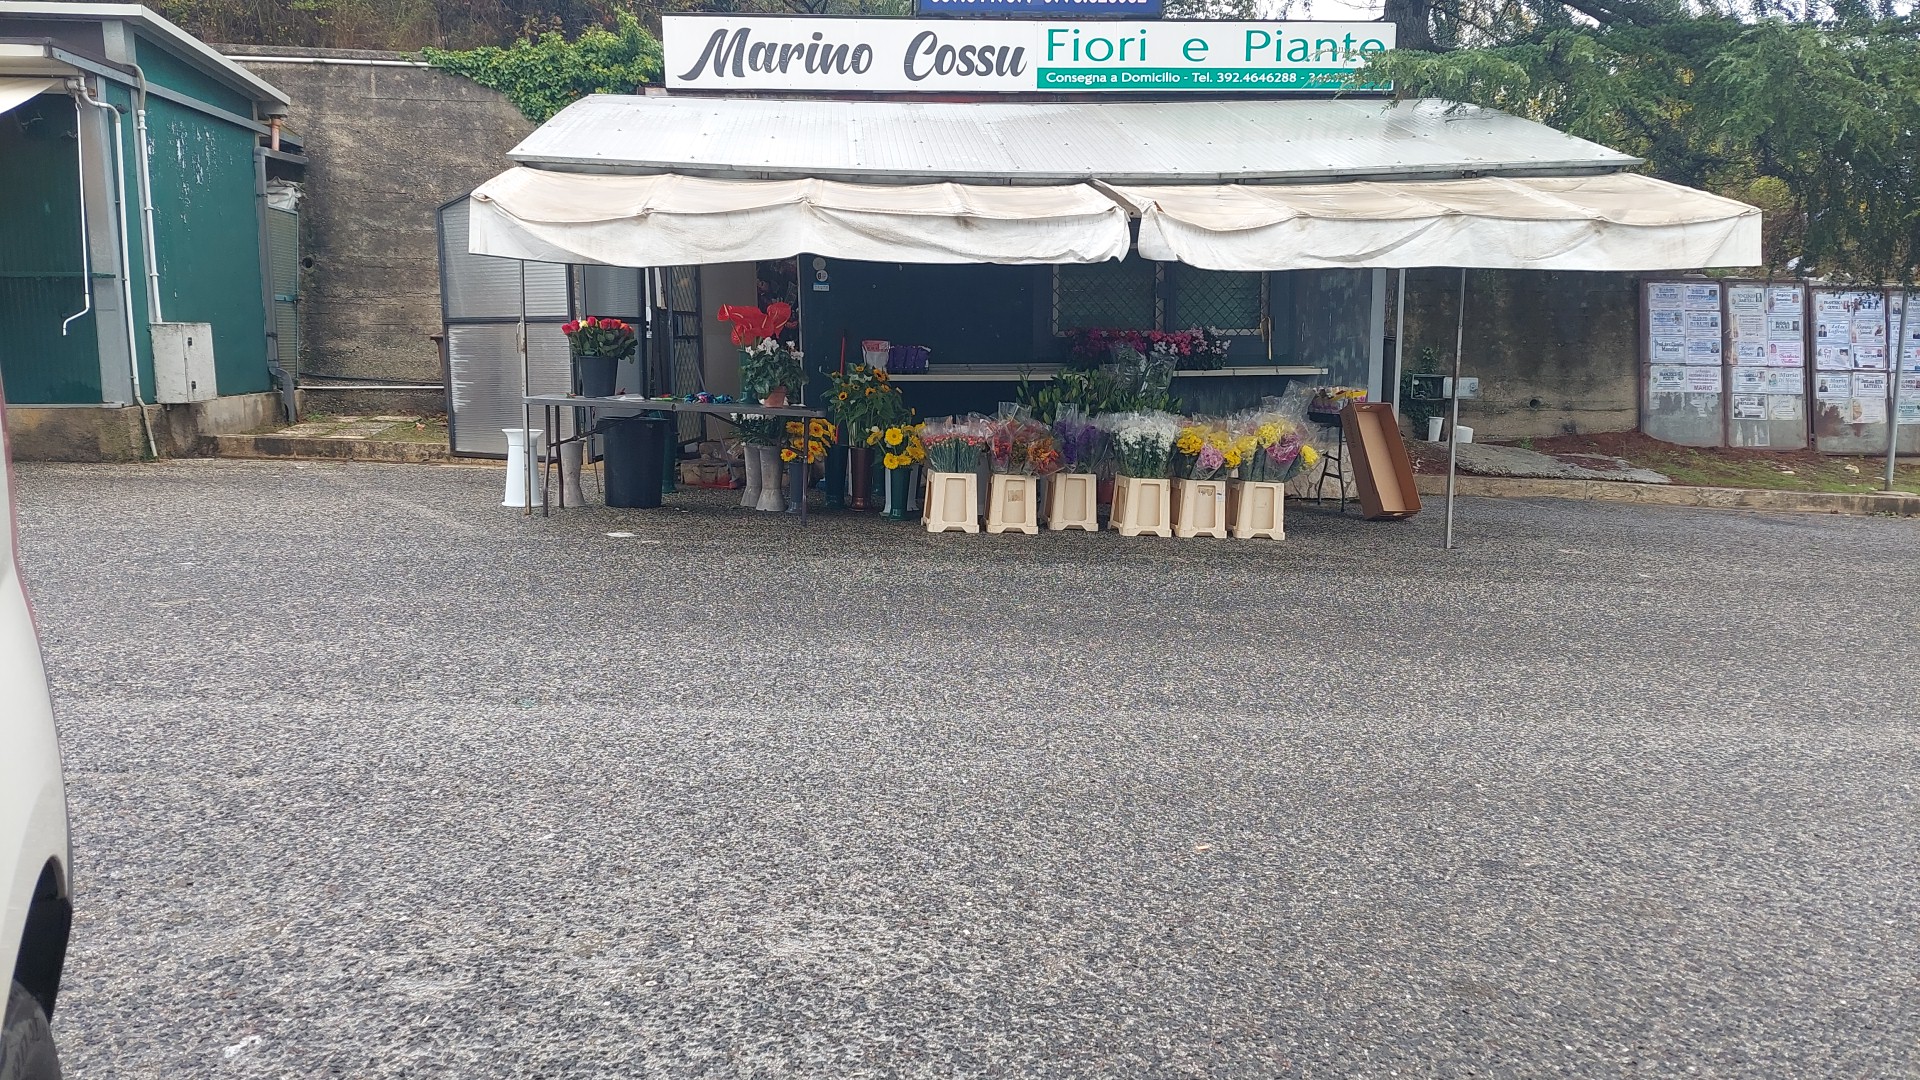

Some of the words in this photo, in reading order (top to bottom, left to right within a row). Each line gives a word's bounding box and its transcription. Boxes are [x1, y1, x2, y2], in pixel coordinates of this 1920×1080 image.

[677, 28, 873, 81] Marino
[904, 30, 1027, 82] Cossu
[1047, 28, 1146, 62] Fiori
[1182, 38, 1209, 62] e
[1245, 29, 1385, 62] Piante
[1046, 72, 1107, 86] Consegna
[1110, 74, 1118, 83] a
[1122, 72, 1180, 83] Domicilio
[1192, 72, 1213, 83] Tel.
[1217, 72, 1297, 83] 392.4646288
